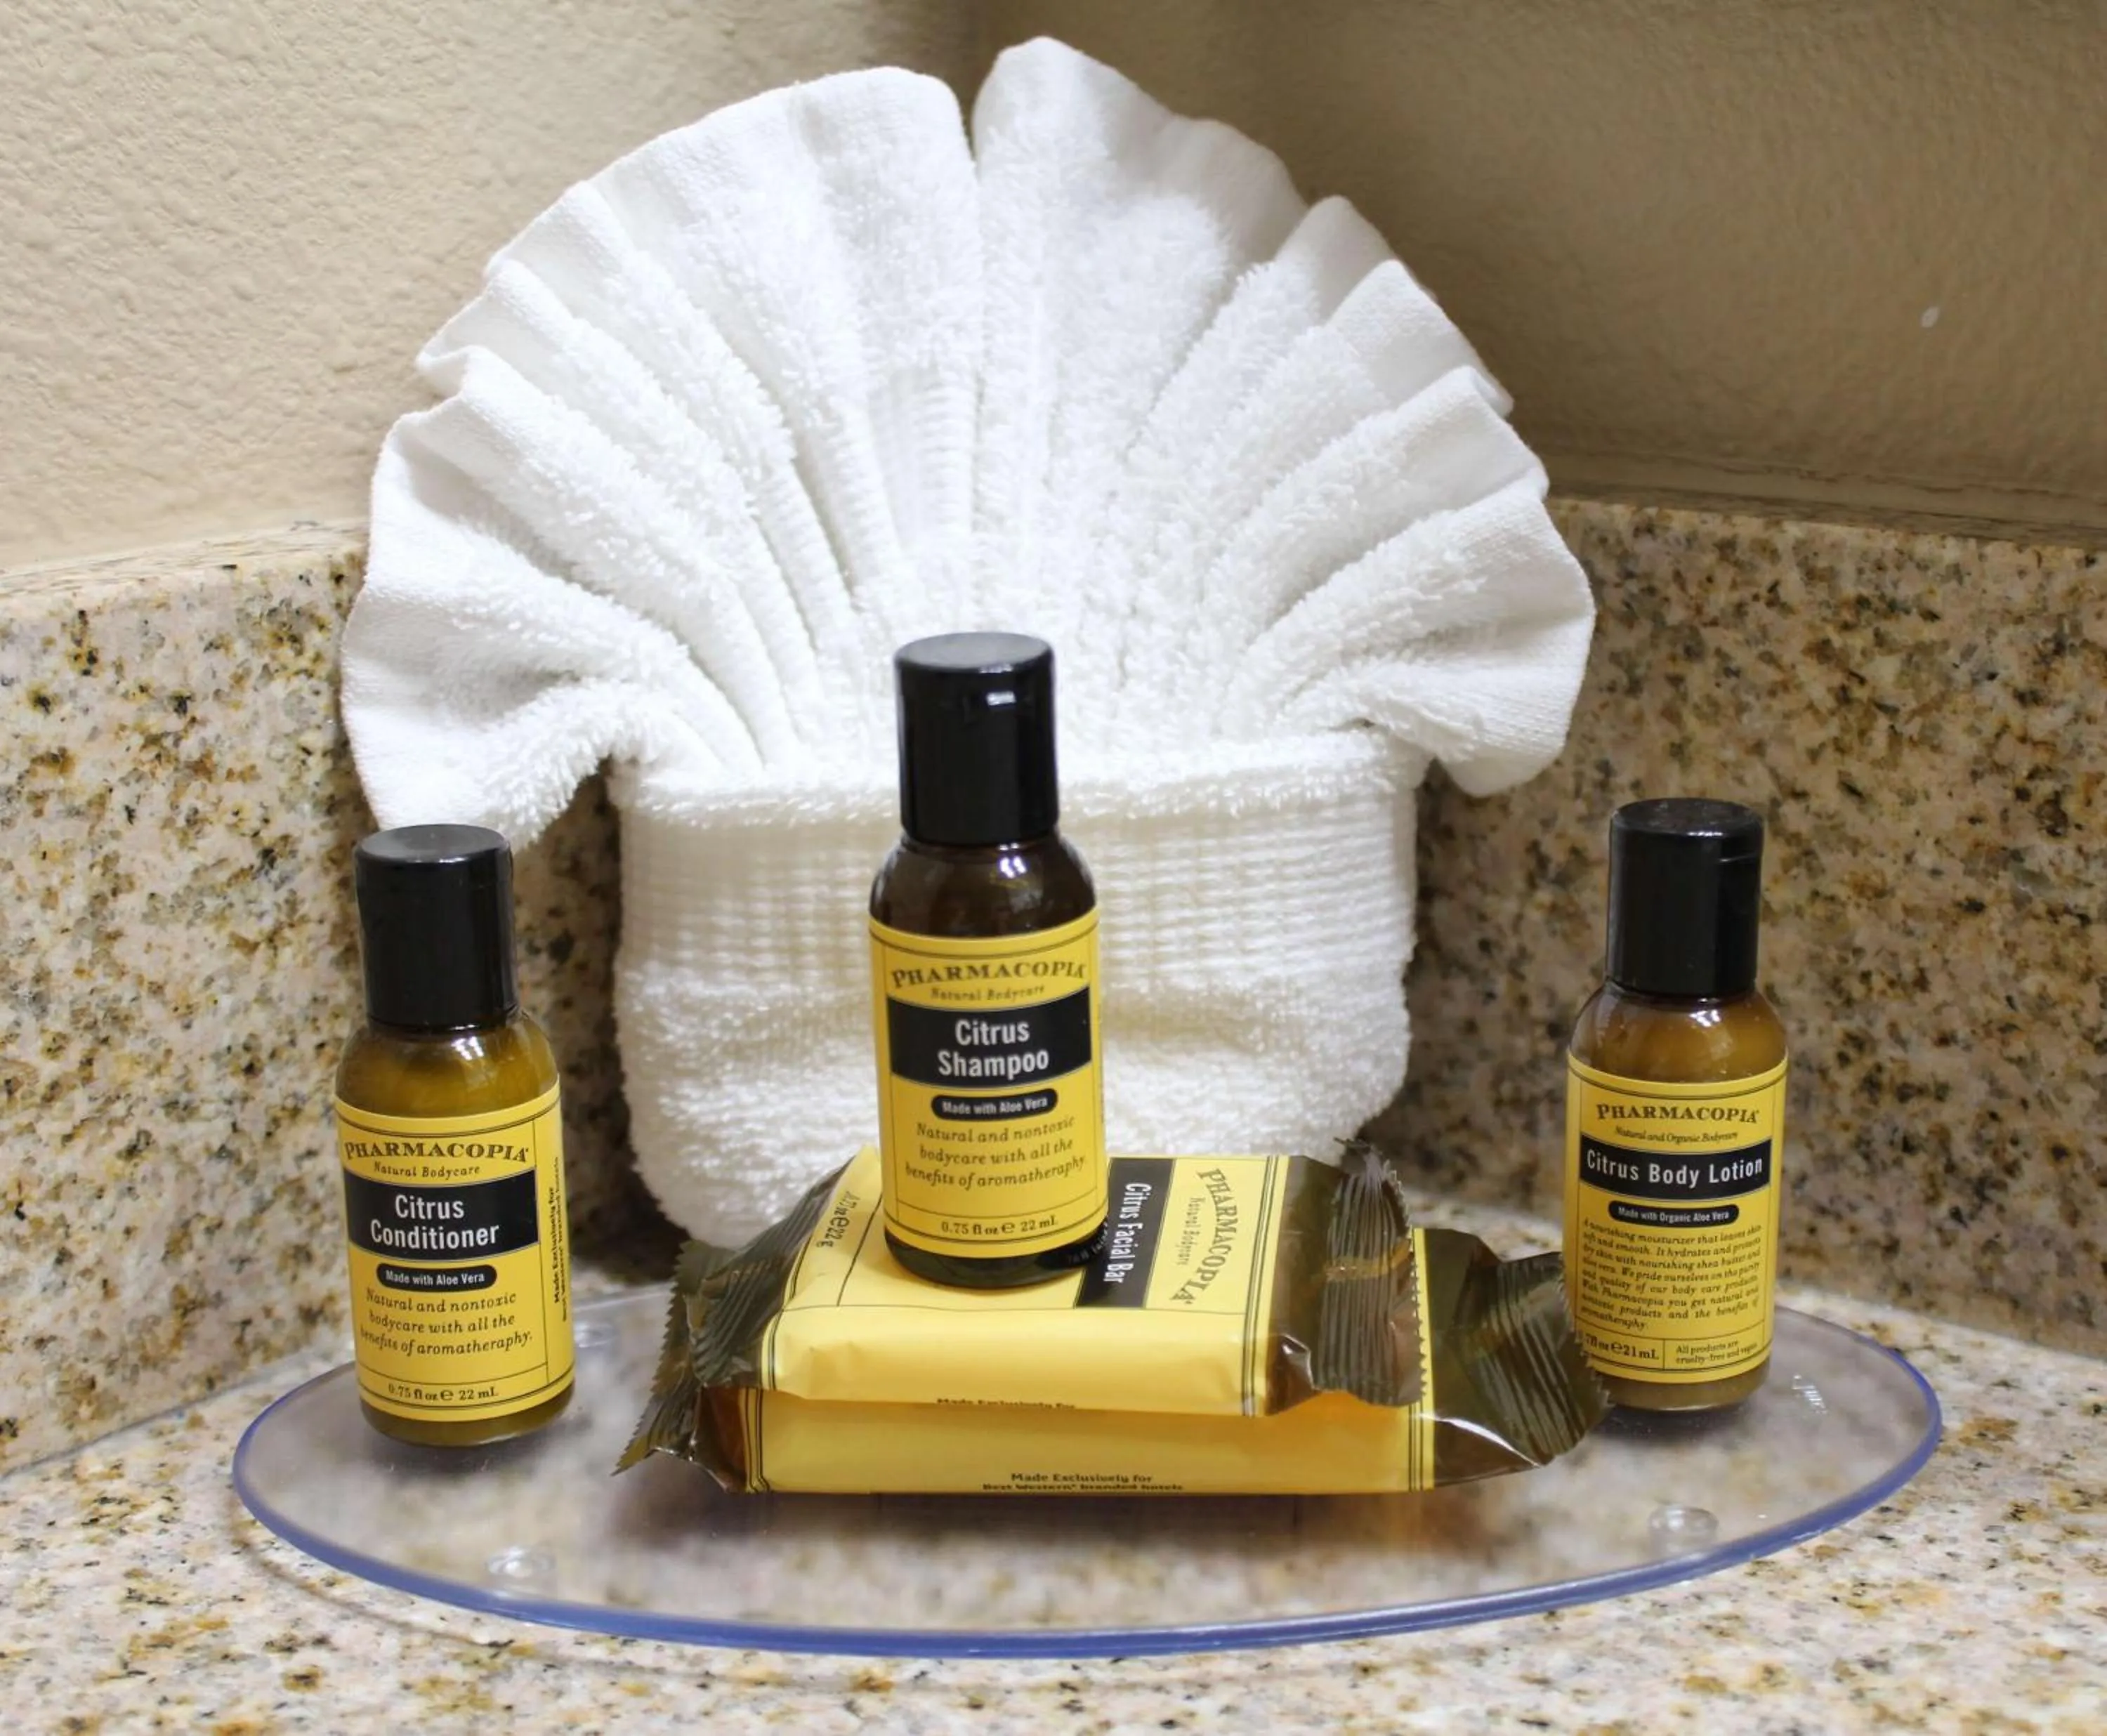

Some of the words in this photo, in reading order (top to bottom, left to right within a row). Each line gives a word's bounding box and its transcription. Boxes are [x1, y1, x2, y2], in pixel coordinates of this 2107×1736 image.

[955, 1020, 1030, 1046] Citrus
[938, 1050, 1049, 1080] Shampoo
[943, 1101, 970, 1114] Made
[973, 1103, 997, 1114] with
[999, 1101, 1021, 1113] Aloe
[1025, 1096, 1048, 1111] Vera
[1596, 1104, 1759, 1123] PHARMACOPIA
[917, 1124, 973, 1143] Natural
[978, 1128, 1008, 1142] and
[1013, 1117, 1075, 1140] nontoxic
[1648, 1131, 1665, 1141] and
[1666, 1133, 1700, 1145] Organic
[344, 1142, 528, 1163] PHARMACOPIA
[919, 1145, 986, 1167] bodycare
[991, 1150, 1025, 1164] with
[1030, 1143, 1050, 1159] all
[1054, 1138, 1073, 1154] the
[374, 1162, 417, 1177] Natural
[422, 1166, 480, 1180] Bodycare
[905, 1162, 954, 1187] benefits
[959, 1173, 975, 1191] of
[1587, 1149, 1639, 1181] Citrus
[1649, 1164, 1699, 1189] Body
[1709, 1157, 1763, 1183] Lotion
[395, 1195, 464, 1220] Citrus
[1119, 1183, 1152, 1218] Citrus
[1618, 1206, 1639, 1218] Made
[1641, 1211, 1658, 1221] with
[1660, 1212, 1692, 1225] Organic
[1693, 1211, 1710, 1221] Aloe
[1712, 1210, 1729, 1220] Vera
[370, 1219, 499, 1250] Conditioner
[941, 1221, 969, 1235] 0.75
[973, 1224, 982, 1235] fl
[985, 1226, 998, 1235] oz
[1020, 1221, 1036, 1232] 22
[1169, 1168, 1238, 1304] PHARMACOPIA
[1110, 1223, 1143, 1259] Facial
[1698, 1235, 1717, 1244] that
[1667, 1247, 1711, 1258] hydrates
[1713, 1244, 1731, 1256] and
[386, 1270, 409, 1284] Made
[413, 1273, 433, 1285] with
[436, 1273, 458, 1285] Aloe
[461, 1271, 485, 1284] Vera
[1103, 1263, 1134, 1283] Bar
[367, 1287, 412, 1311] Natural
[416, 1299, 446, 1313] and
[450, 1292, 517, 1312] nontoxic
[1672, 1285, 1696, 1297] body
[369, 1310, 424, 1333] bodycare
[429, 1320, 463, 1334] with
[467, 1316, 488, 1331] all
[492, 1313, 515, 1327] the
[1668, 1310, 1688, 1319] and
[1695, 1310, 1711, 1319] the
[401, 1339, 415, 1357] of
[1624, 1345, 1636, 1356] 21
[1676, 1345, 1688, 1354] All
[1691, 1343, 1727, 1355] products
[388, 1383, 411, 1398] 0.75
[414, 1388, 422, 1400] fl
[425, 1393, 438, 1401] oz
[458, 1390, 475, 1400] 22
[1011, 1473, 1049, 1481] Made
[1054, 1473, 1129, 1482] Exclusively
[1133, 1473, 1152, 1482] for
